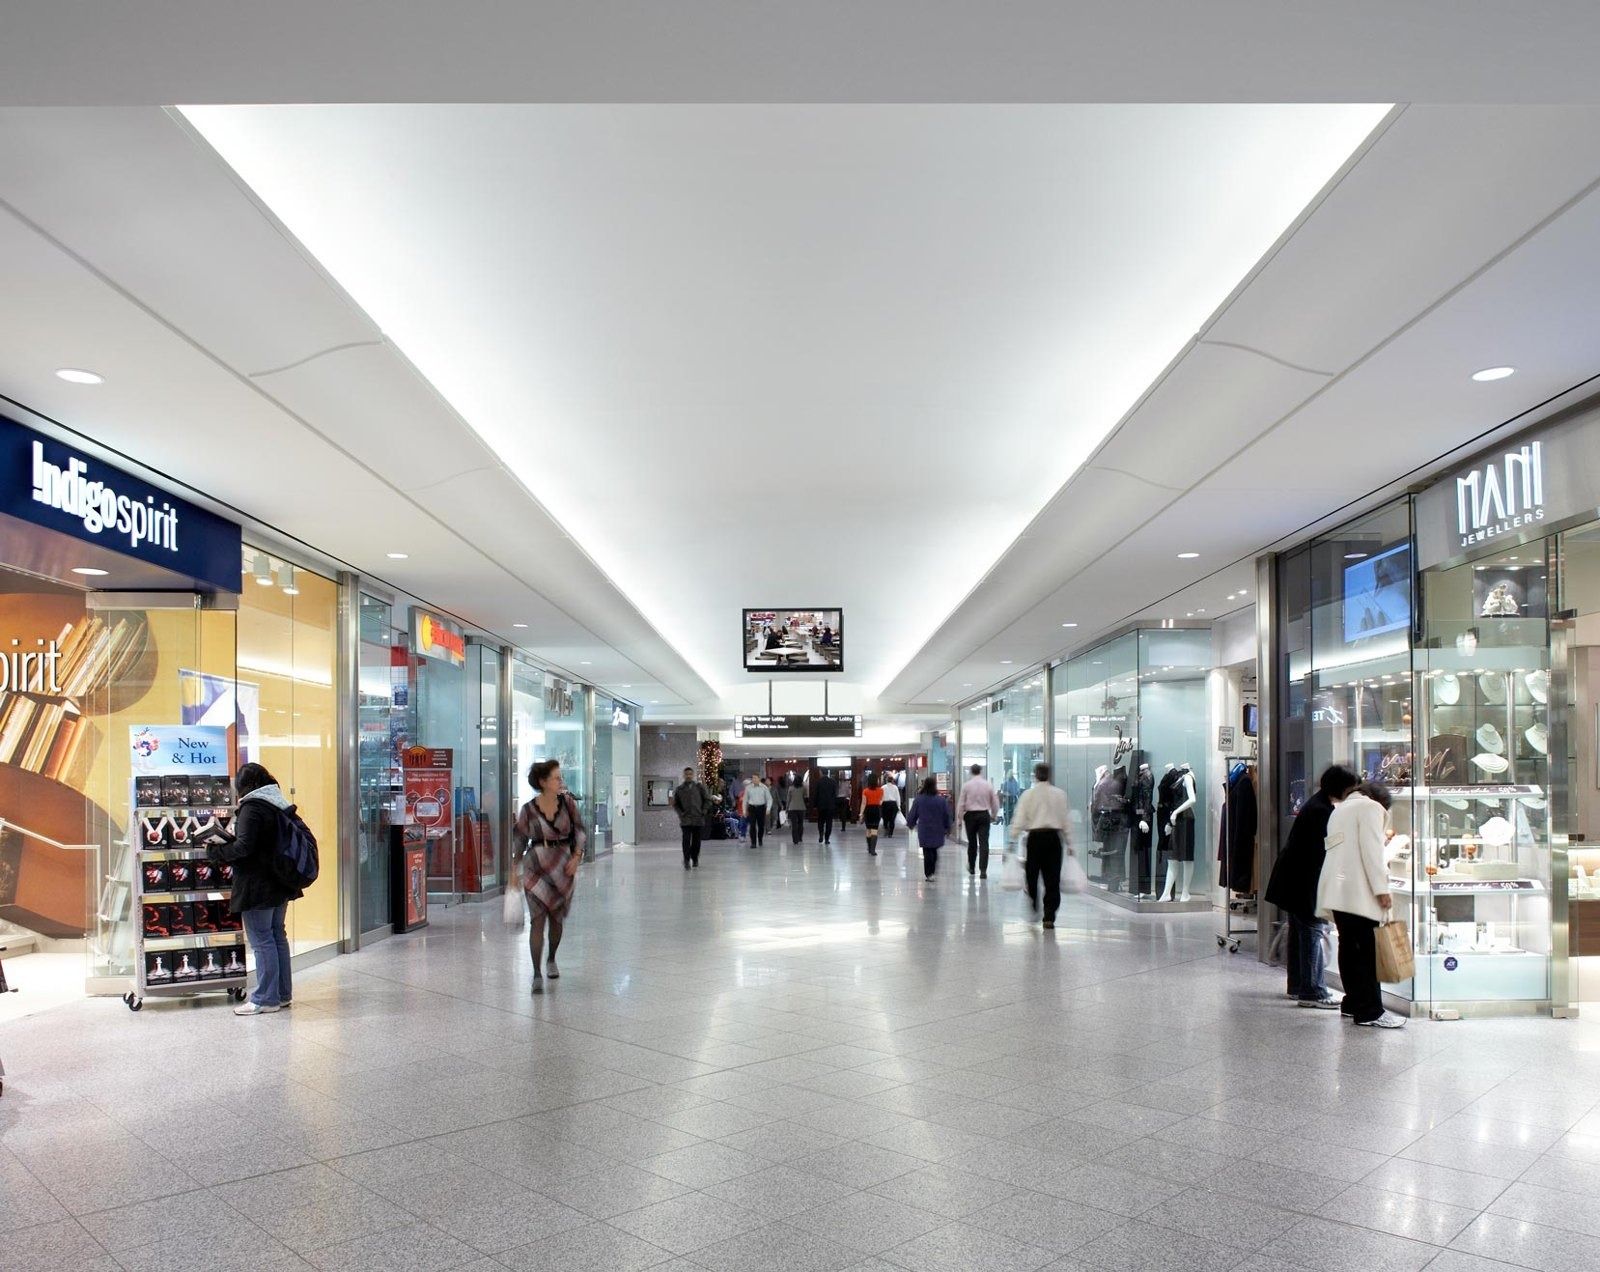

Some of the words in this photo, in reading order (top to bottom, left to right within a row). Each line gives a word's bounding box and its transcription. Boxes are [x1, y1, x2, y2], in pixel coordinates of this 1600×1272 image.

[1456, 440, 1544, 534] MANI
[1461, 509, 1544, 547] JEWELLERS
[178, 738, 209, 749] New
[172, 752, 185, 764] &
[190, 752, 217, 764] Hot
